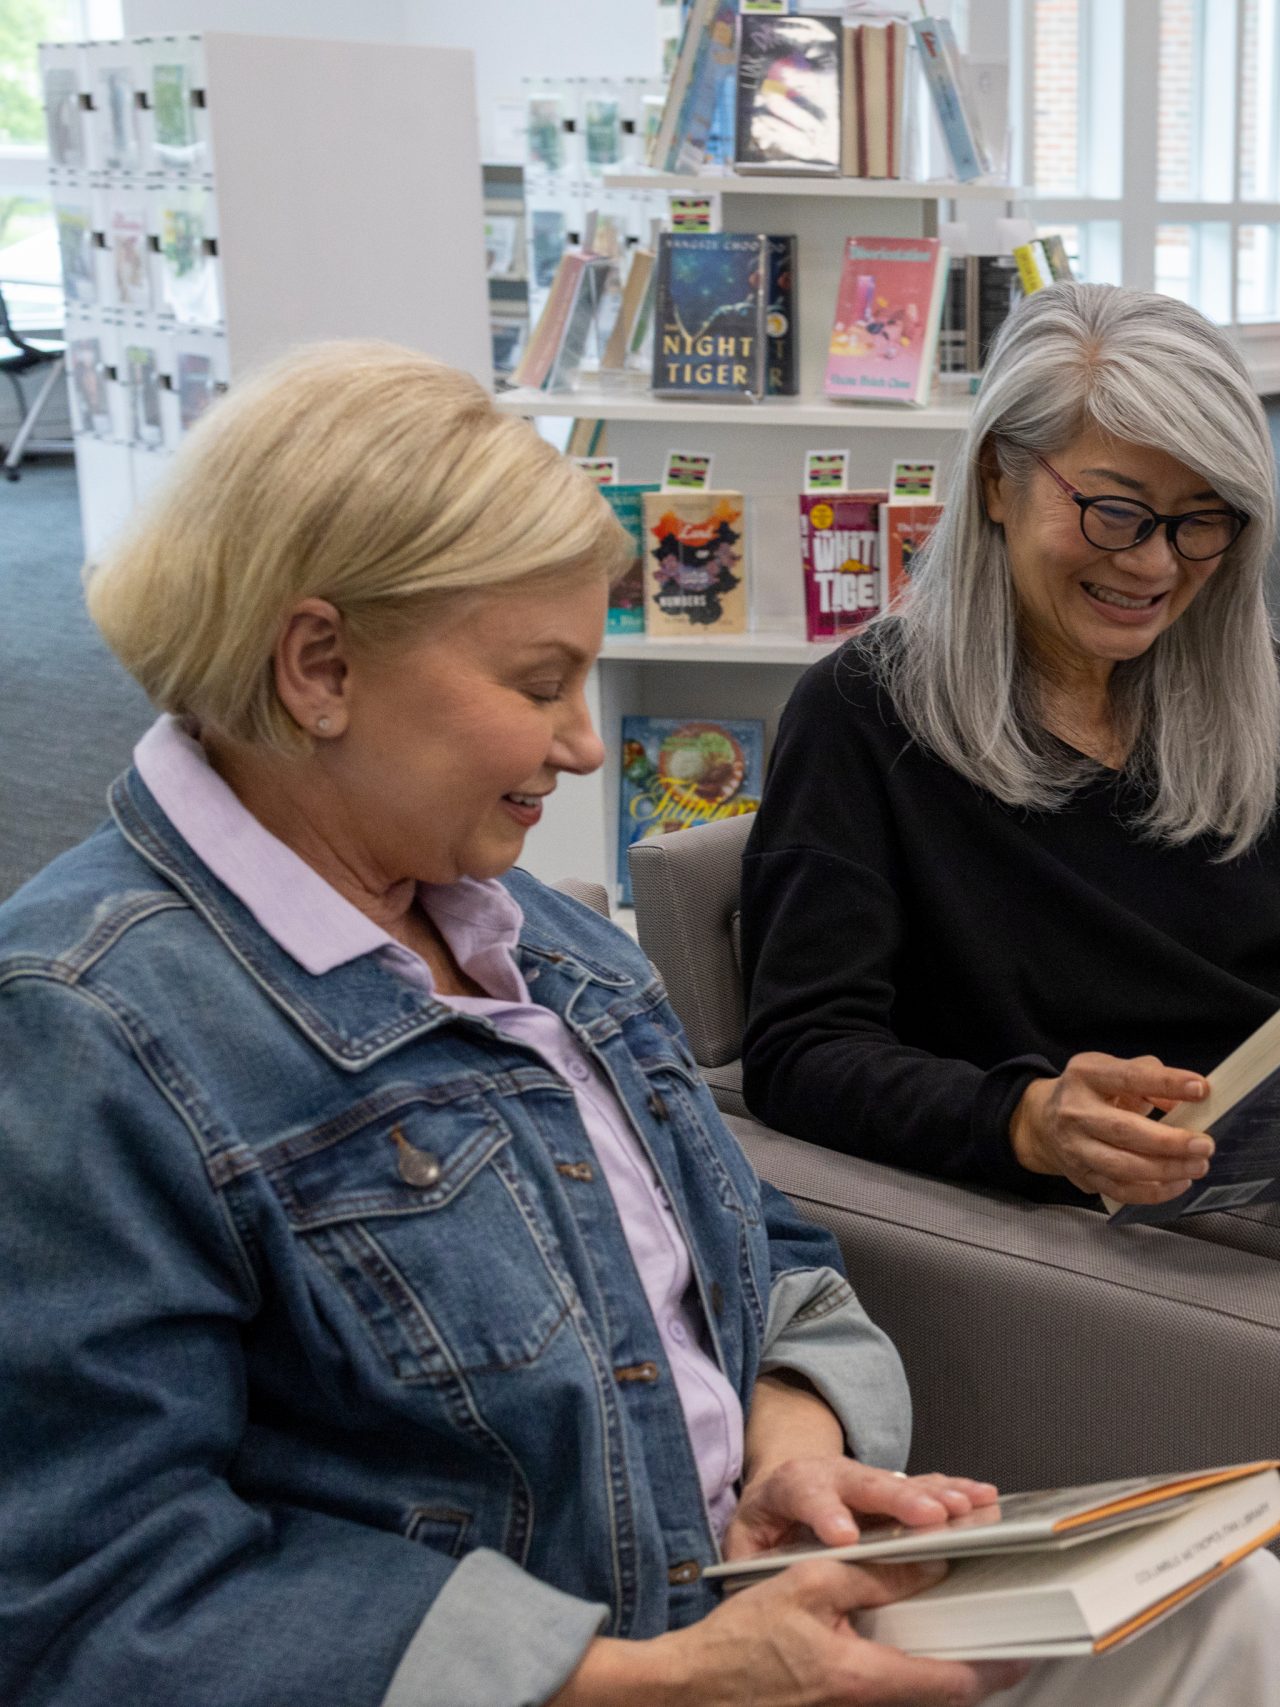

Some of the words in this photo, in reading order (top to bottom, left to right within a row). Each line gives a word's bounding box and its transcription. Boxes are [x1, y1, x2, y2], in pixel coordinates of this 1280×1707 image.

[662, 335, 753, 358] NIGHT
[667, 362, 749, 385] TIGER
[659, 594, 708, 609] NUMBERS
